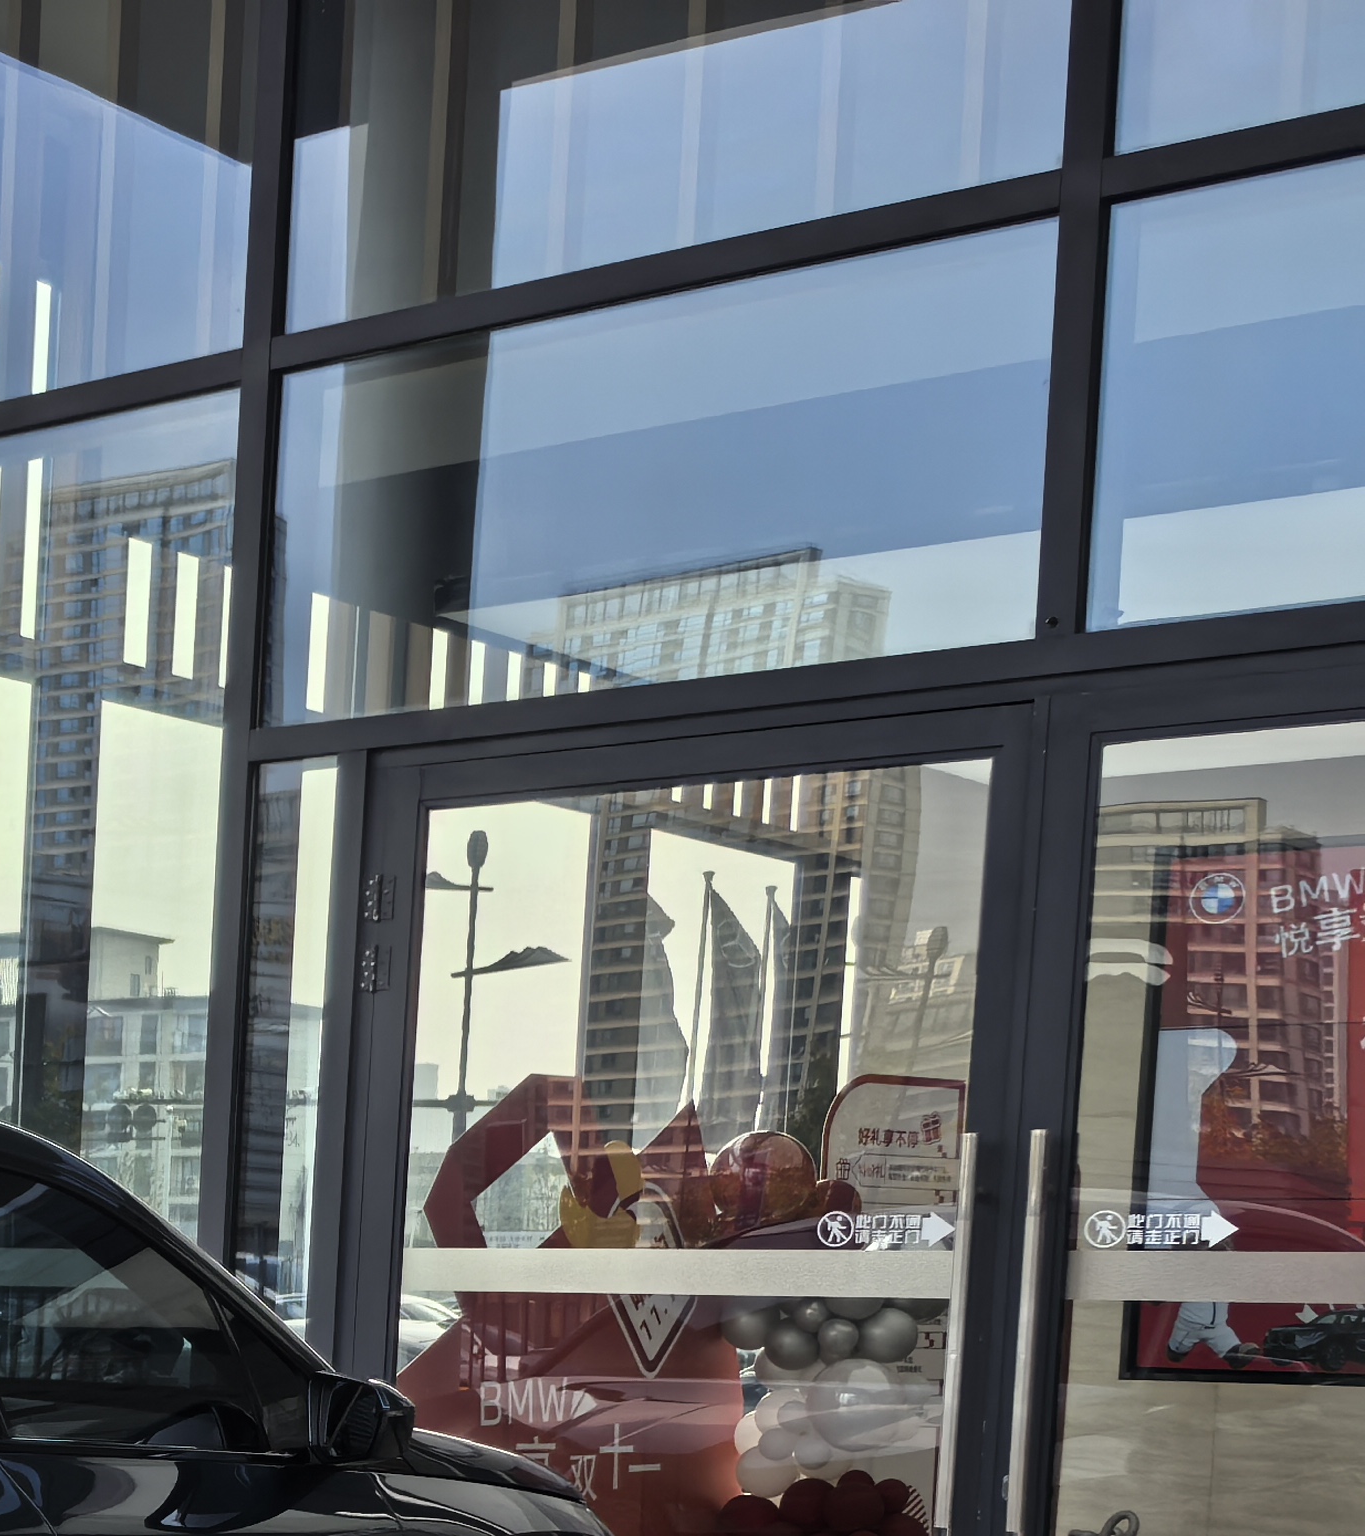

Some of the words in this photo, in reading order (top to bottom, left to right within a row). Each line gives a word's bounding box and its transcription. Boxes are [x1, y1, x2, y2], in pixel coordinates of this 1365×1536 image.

[1271, 867, 1365, 913] BMW
[1274, 902, 1365, 958] 悦享
[855, 1213, 922, 1230] 此门不通
[1127, 1213, 1201, 1230] 此门不通
[1126, 1229, 1200, 1246] 请走正门
[480, 1376, 568, 1427] BMW
